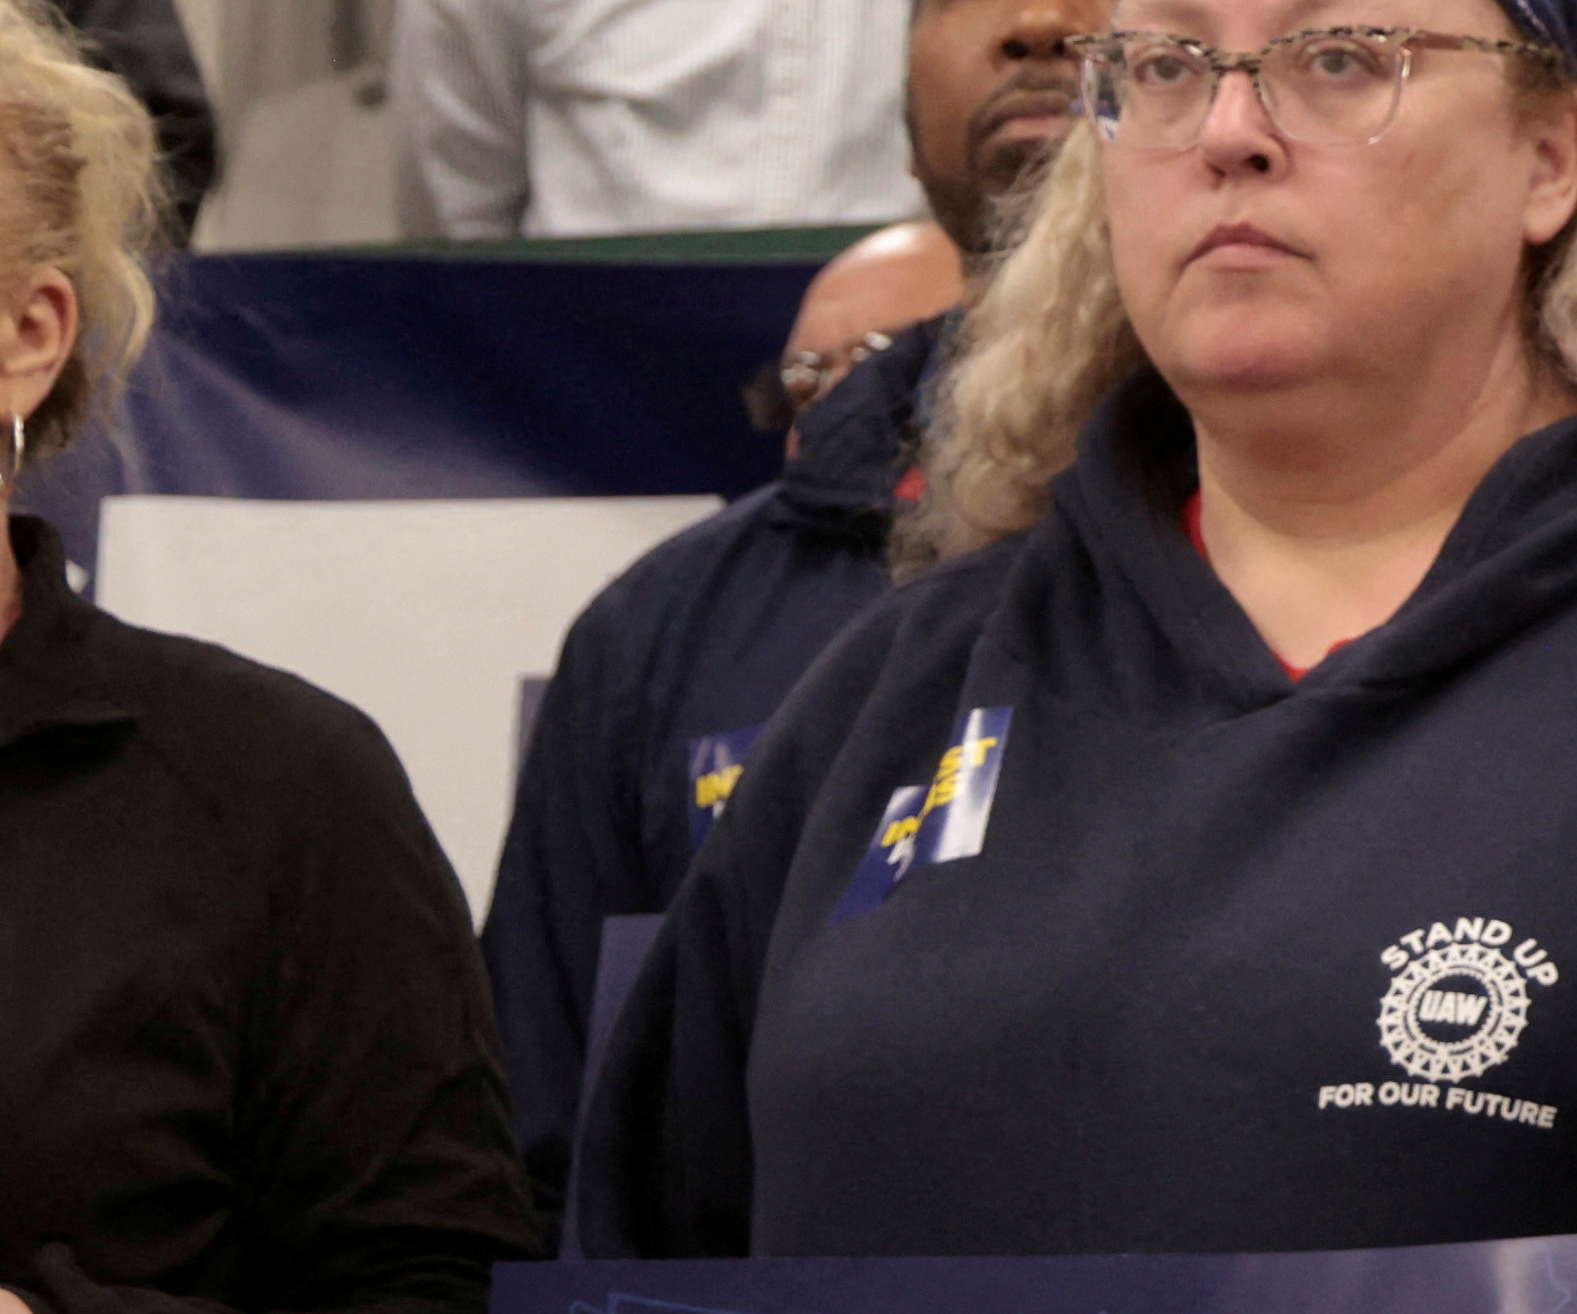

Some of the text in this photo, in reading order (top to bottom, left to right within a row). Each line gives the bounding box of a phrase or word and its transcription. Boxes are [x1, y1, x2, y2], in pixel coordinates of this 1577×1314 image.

[1379, 915, 1560, 988] STAND UP
[1417, 989, 1489, 1027] UAW
[1317, 1080, 1559, 1130] FOR OUR FUTURE
